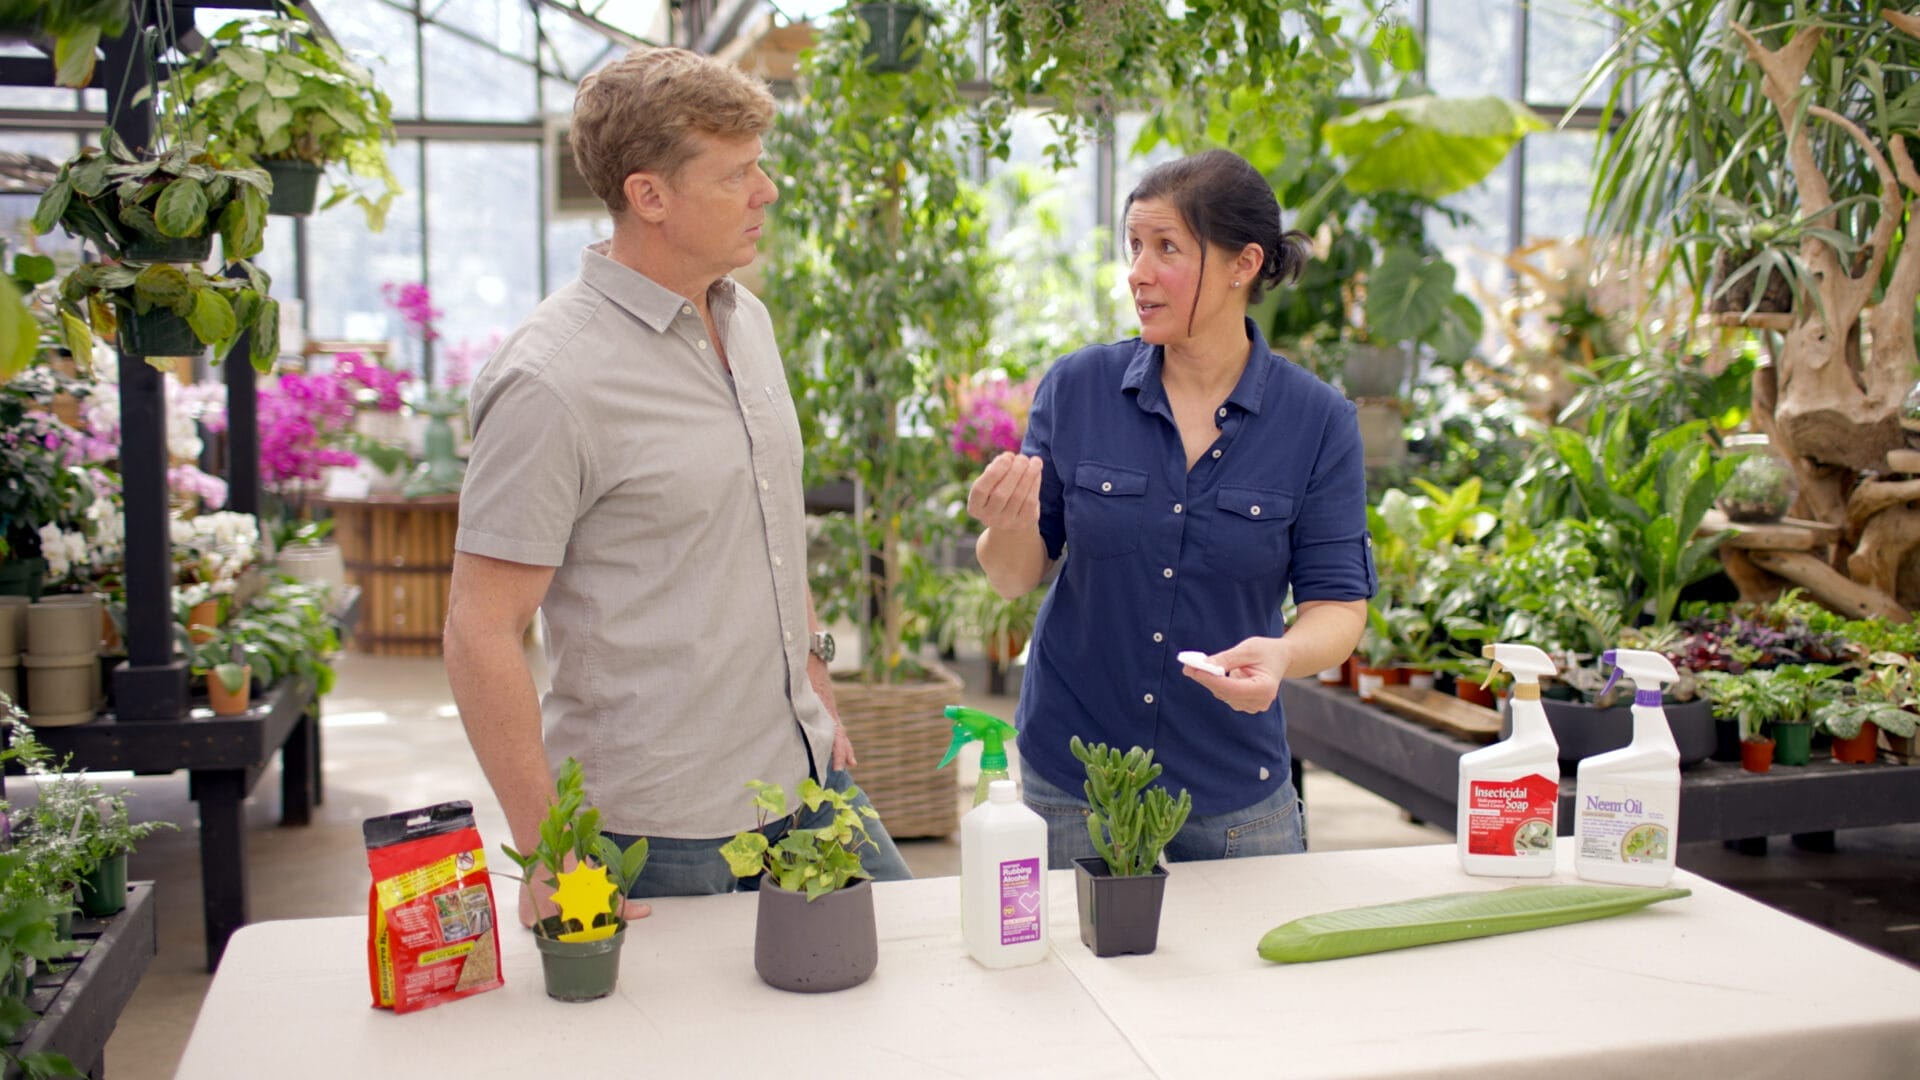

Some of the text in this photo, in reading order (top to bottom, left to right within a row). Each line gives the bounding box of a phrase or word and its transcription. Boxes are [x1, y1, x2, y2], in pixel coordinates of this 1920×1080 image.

[1475, 786, 1527, 798] Insecticidal
[1505, 799, 1529, 812] Soap
[1586, 796, 1643, 814] Neem Oil
[1003, 867, 1032, 876] Rubbing
[1003, 874, 1029, 882] Alcohol
